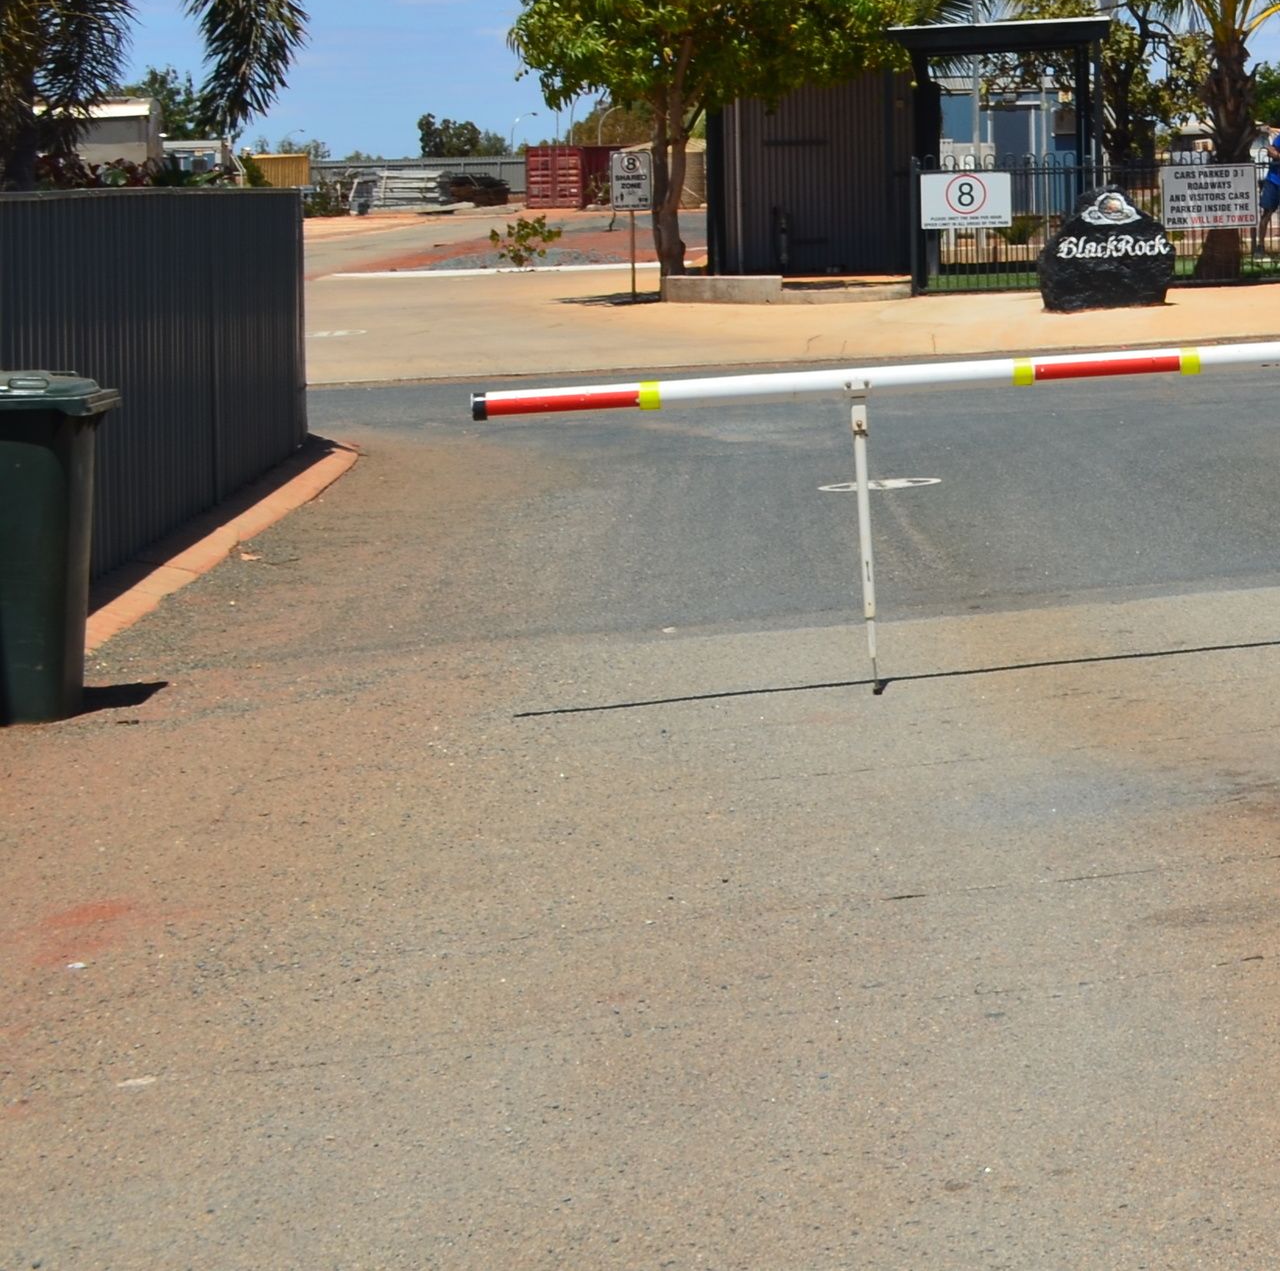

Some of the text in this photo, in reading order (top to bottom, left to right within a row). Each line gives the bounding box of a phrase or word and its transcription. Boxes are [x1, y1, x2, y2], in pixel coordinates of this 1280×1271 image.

[626, 157, 637, 171] 8
[1174, 171, 1196, 180] CARS
[1198, 169, 1230, 178] PARKED
[1187, 181, 1232, 190] ROADWAYS
[958, 182, 975, 207] 8
[1169, 191, 1250, 202] AND VISITORS CARS
[1170, 202, 1249, 214] PARKED INSIDE THE
[1167, 217, 1188, 225] PARK
[1212, 215, 1224, 223] BE
[1226, 214, 1255, 223] TOWED
[1056, 234, 1171, 259] BlackRock
